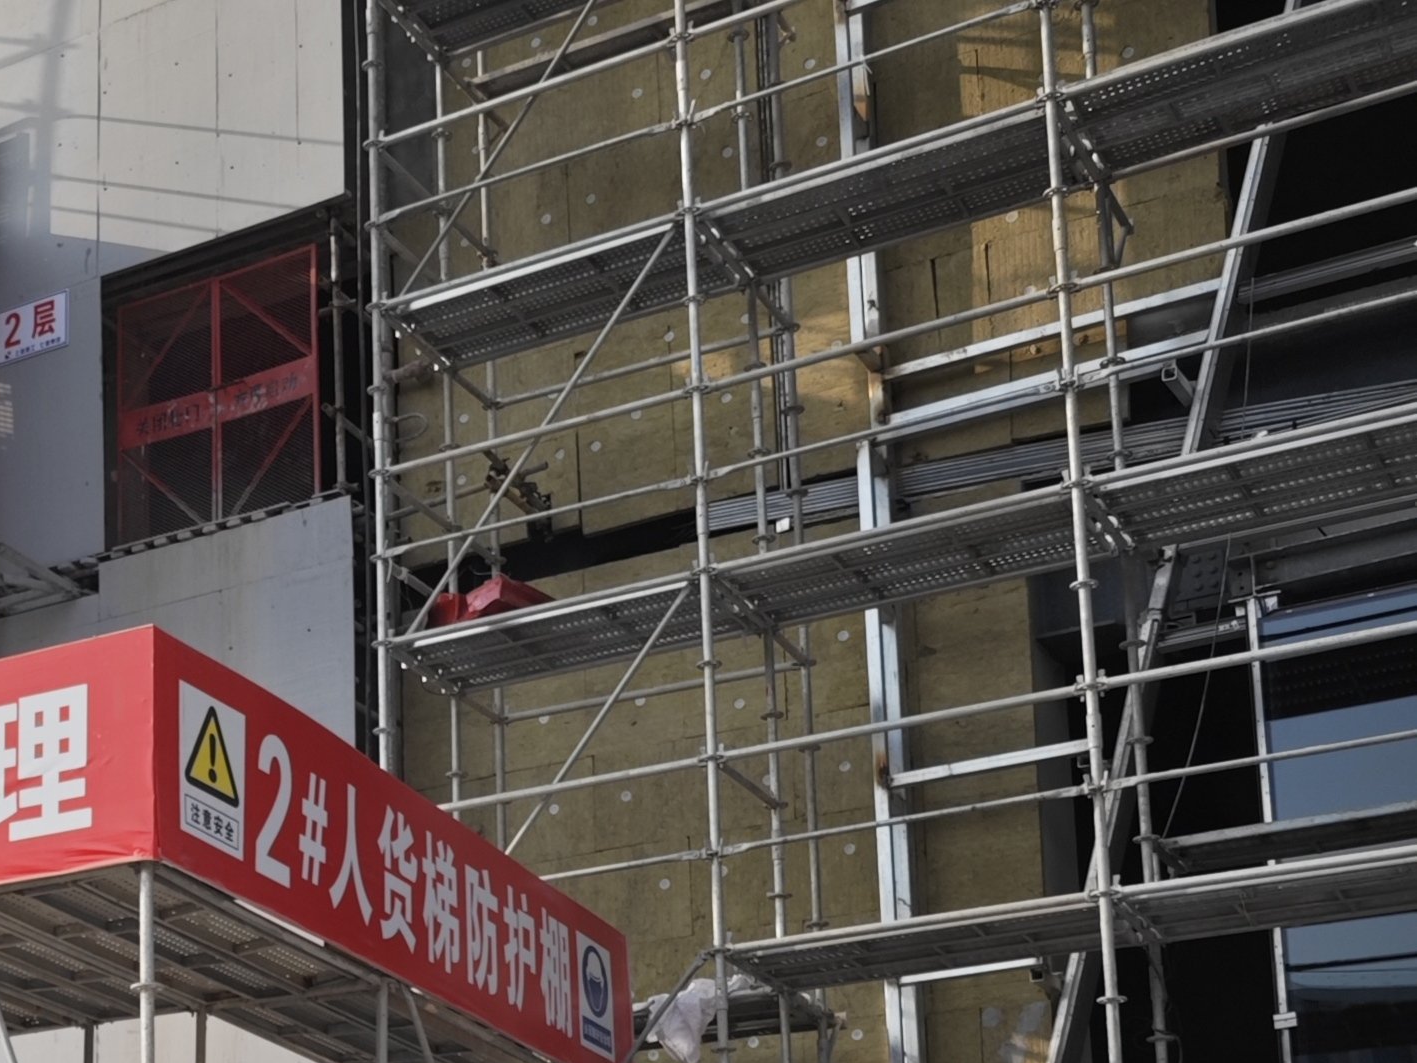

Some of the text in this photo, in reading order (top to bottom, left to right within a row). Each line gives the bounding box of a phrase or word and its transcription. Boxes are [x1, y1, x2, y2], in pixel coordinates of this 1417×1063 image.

[190, 802, 234, 842] 注意安全
[254, 734, 573, 1039] 2#人货梯防护棚
